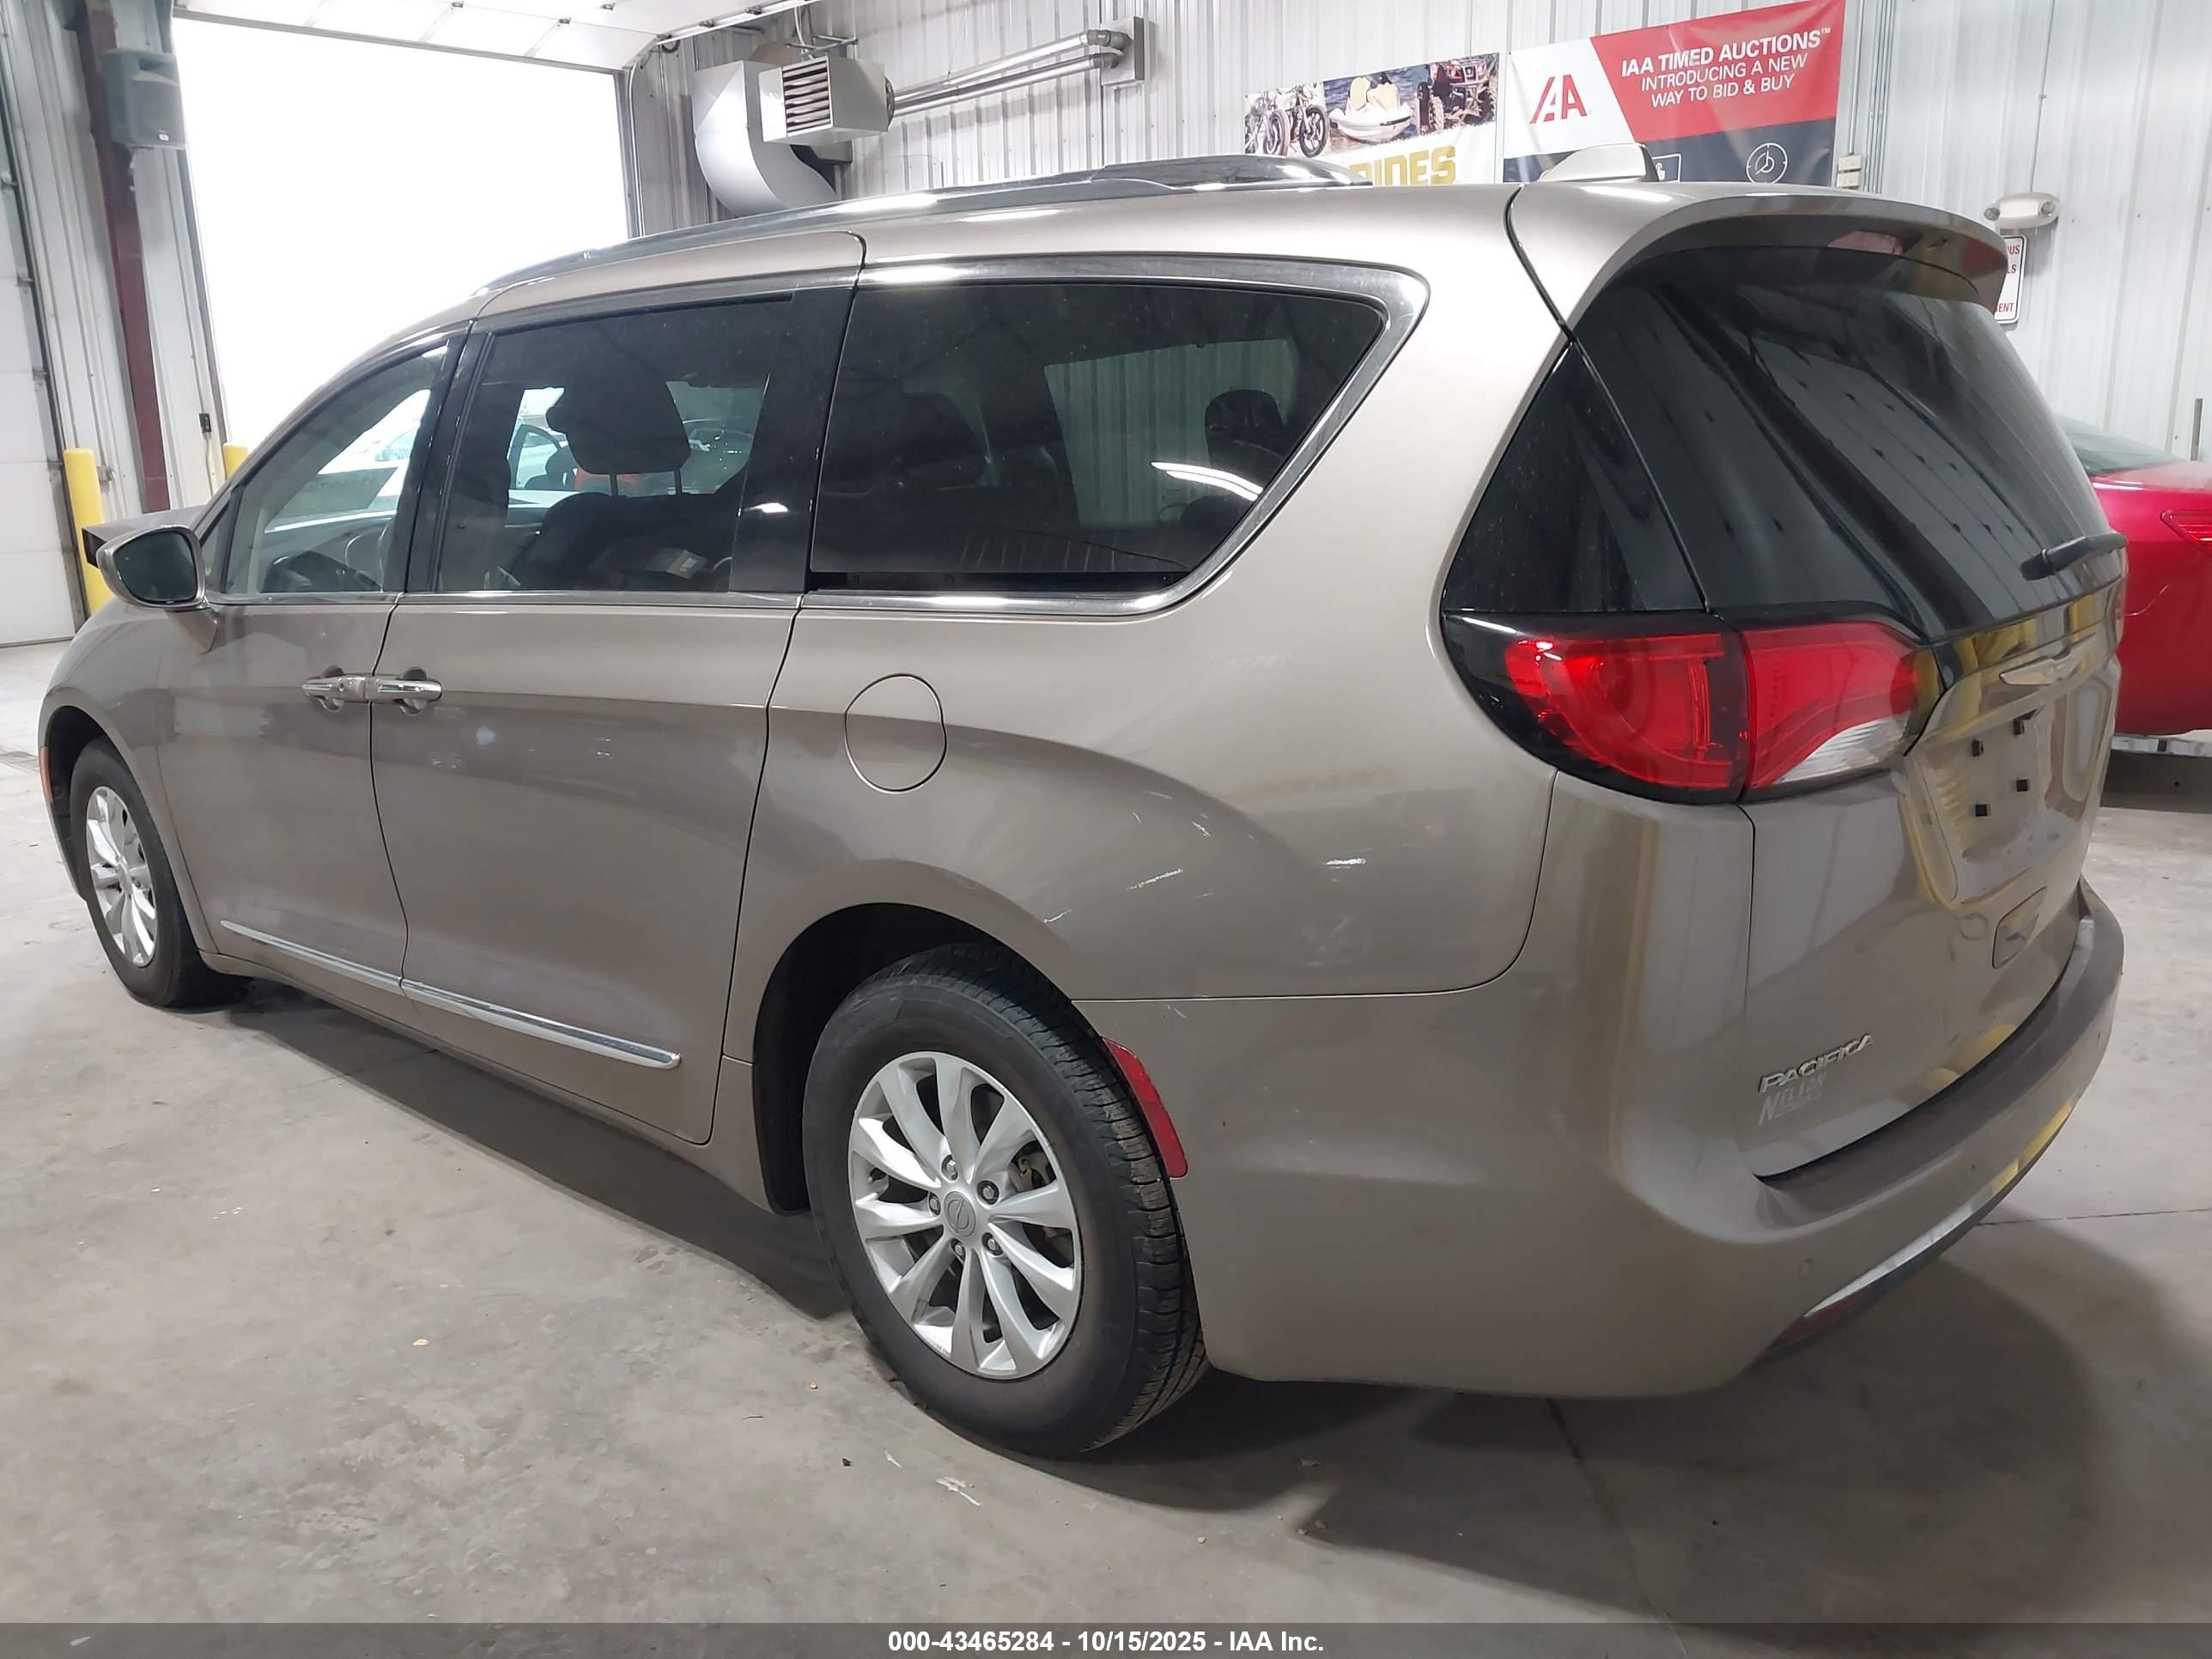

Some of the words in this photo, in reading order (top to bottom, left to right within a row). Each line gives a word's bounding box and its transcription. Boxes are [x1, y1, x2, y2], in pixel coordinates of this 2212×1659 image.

[1621, 56, 1654, 77] IAA
[1658, 46, 1714, 72] TIMED
[1641, 62, 1747, 92] INTRODUCING
[1751, 60, 1763, 75] A
[1768, 52, 1808, 73] NEW
[1650, 89, 1685, 108] WAY
[1688, 85, 1708, 102] TO
[1713, 82, 1739, 99] BID
[1742, 79, 1756, 94] &
[1760, 73, 1796, 93] BUY
[1759, 1033, 1874, 1093] PACIFICA
